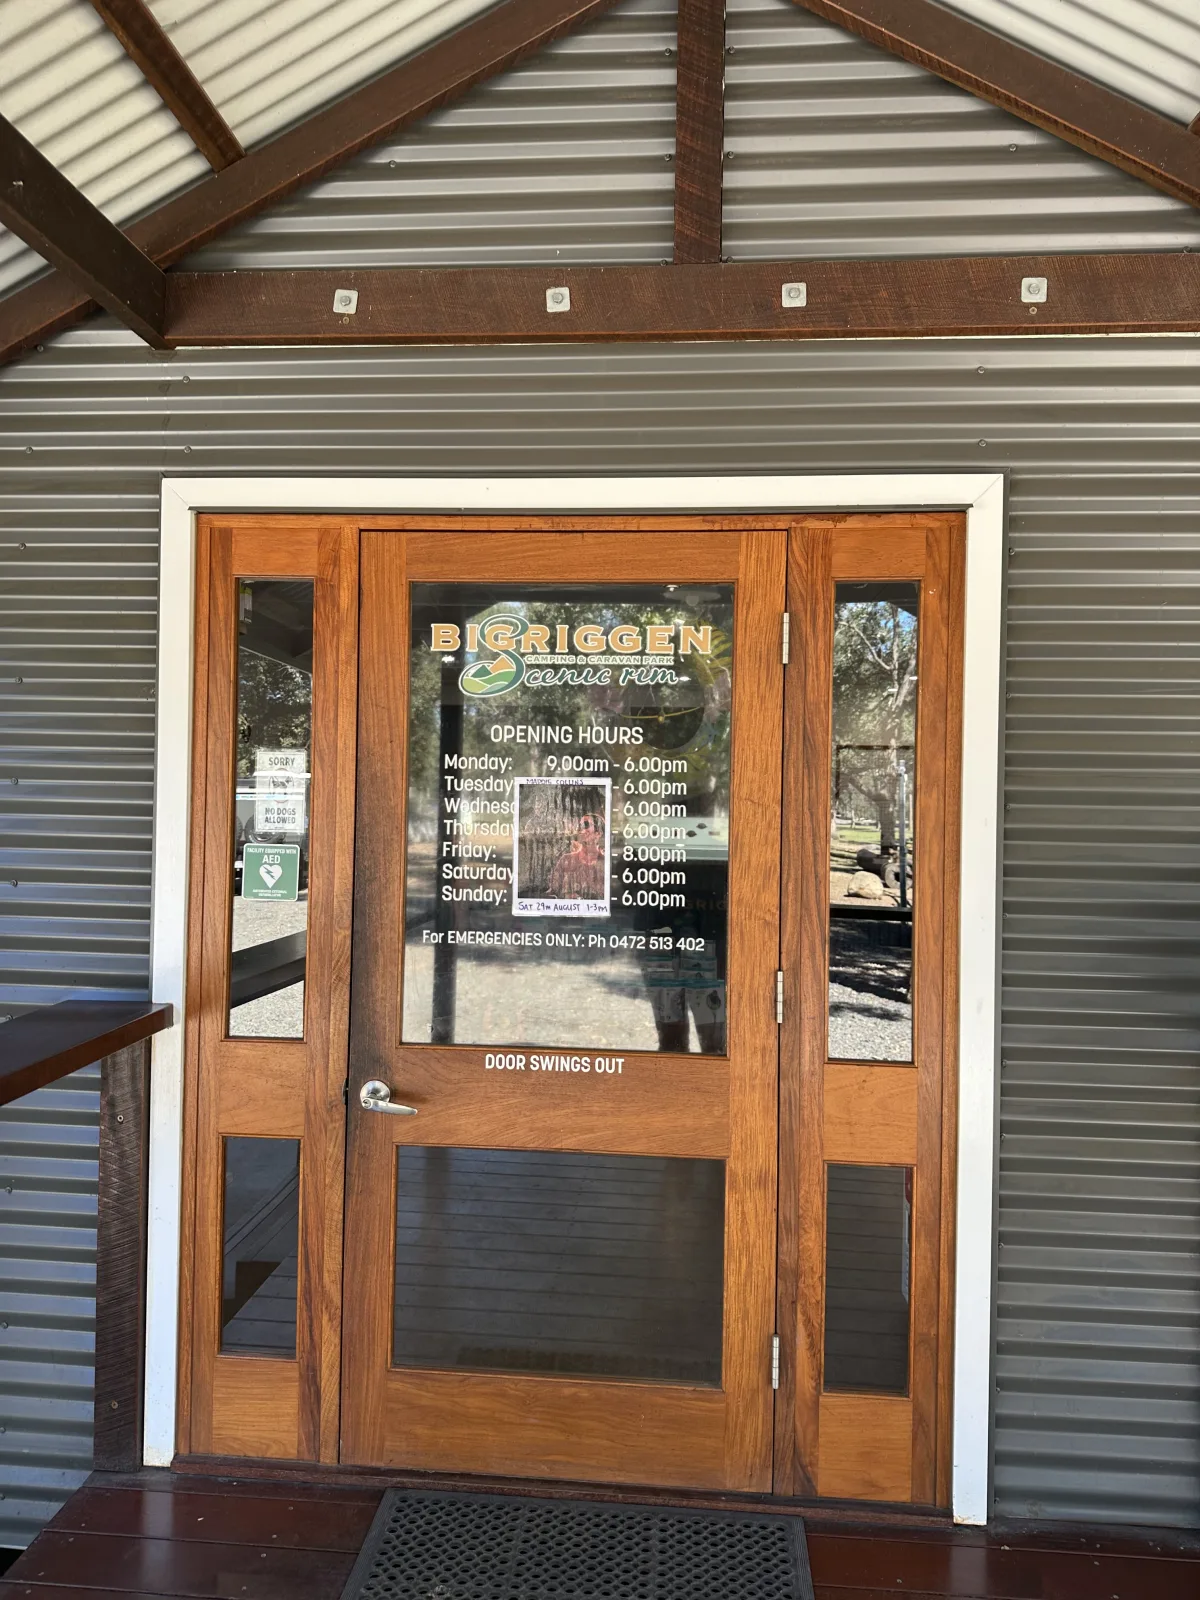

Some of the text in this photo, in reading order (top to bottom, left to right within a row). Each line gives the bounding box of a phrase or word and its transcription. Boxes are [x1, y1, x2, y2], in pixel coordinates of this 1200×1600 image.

[525, 655, 674, 665] CAMPING & CARAVAN PARK
[619, 667, 678, 686] rim
[490, 724, 643, 745] OPENING HOURS
[269, 757, 295, 766] SORRY
[444, 754, 512, 774] Monday:
[547, 755, 609, 772] 9.00am
[624, 757, 687, 777] 6.00pm
[623, 779, 687, 798] 6.00pm
[265, 807, 296, 816] NO DOGS
[265, 816, 296, 824] ALLOWED
[623, 801, 687, 820] 6.00pm
[622, 823, 686, 842] 6.00pm
[262, 855, 280, 864] AED
[443, 840, 496, 861] Friday:
[622, 845, 686, 866] 8.00pm
[622, 868, 686, 889] 6.00pm
[442, 885, 507, 905] Sunday:
[621, 890, 686, 910] 6.00pm
[422, 930, 705, 951] For EMERGENCIES ONLY: Ph 0472 513 402
[485, 1053, 625, 1074] DOOR SWINGS OUT
